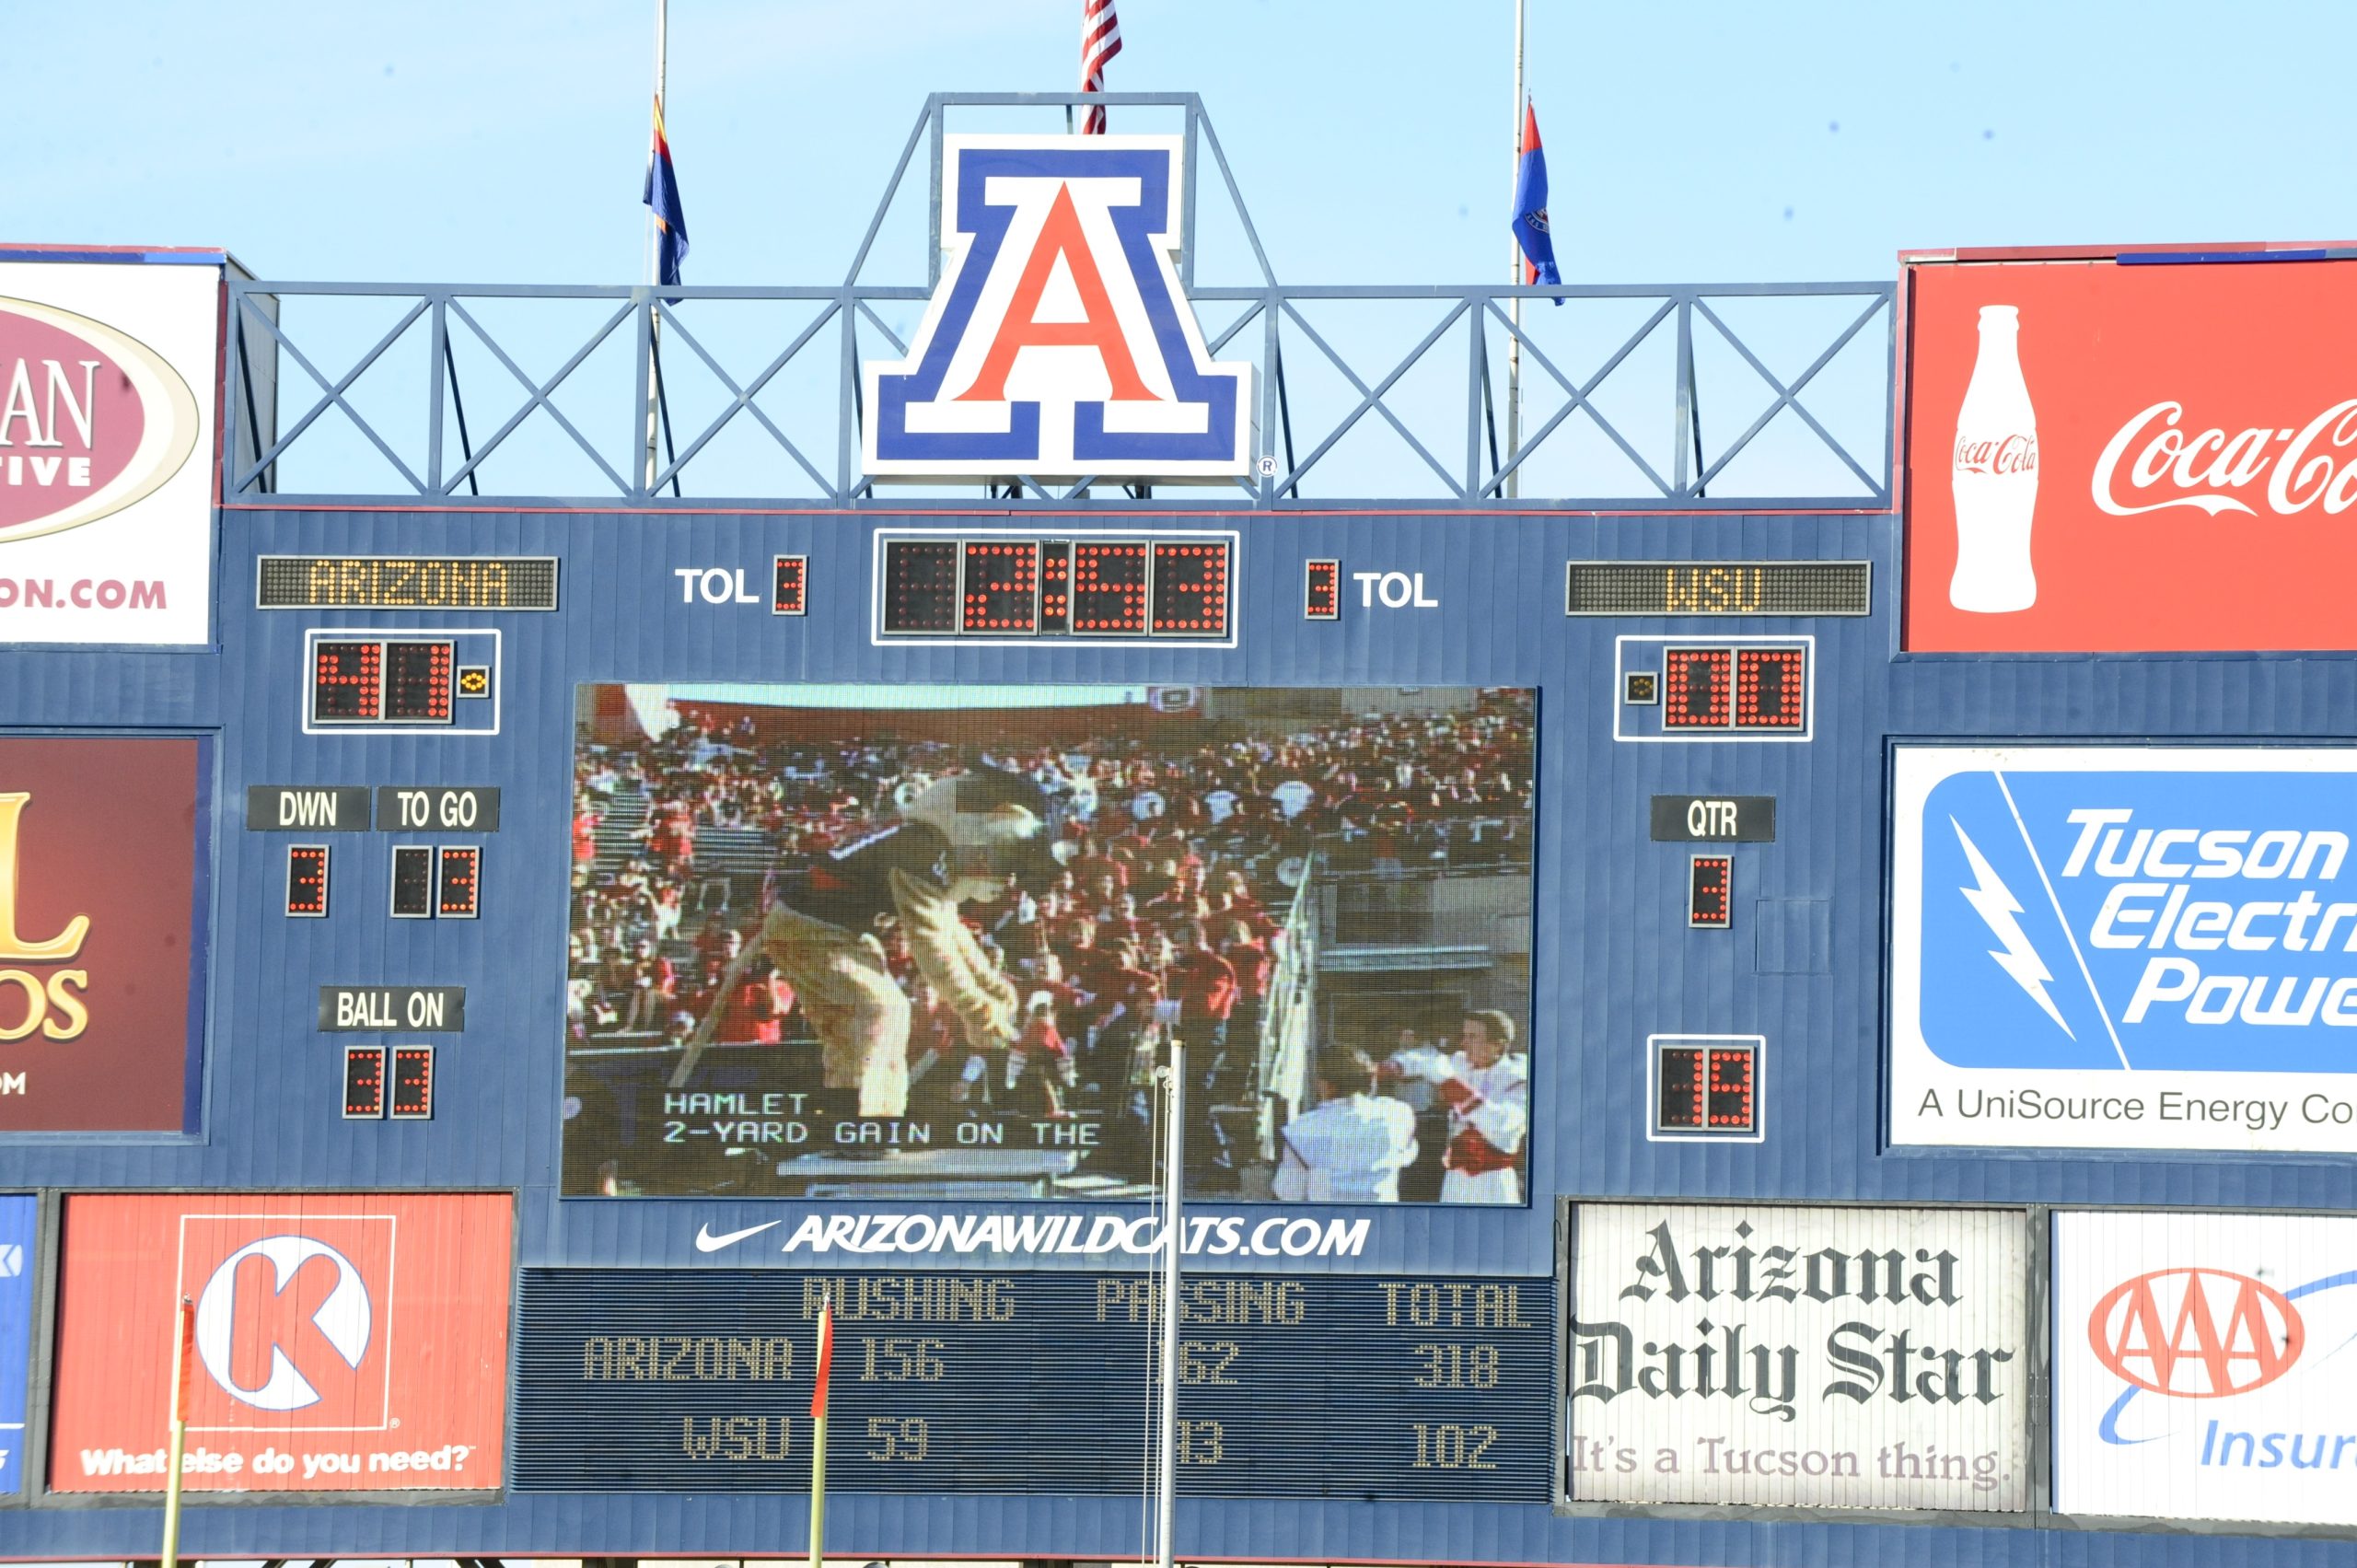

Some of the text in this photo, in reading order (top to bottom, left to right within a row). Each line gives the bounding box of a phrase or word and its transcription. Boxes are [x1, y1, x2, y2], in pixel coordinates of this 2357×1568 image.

[0, 456, 90, 487] IVE
[1956, 434, 2036, 474] Coca-Cola
[0, 578, 167, 610] ON.COM
[309, 559, 507, 606] ARIZONA
[675, 568, 760, 604] TOL
[1353, 571, 1438, 609] TOL
[1666, 568, 1762, 612] WSU
[279, 791, 337, 826] DWN
[397, 791, 477, 827] TO GO
[1688, 799, 1736, 836] QTR
[2061, 808, 2349, 879] Tucson
[289, 851, 325, 911] 3
[1692, 860, 1727, 920] 3
[337, 992, 444, 1028] BALL ON
[1918, 1088, 1944, 1117] A
[1957, 1089, 2144, 1120] UniSource
[2160, 1091, 2288, 1130] Energy
[664, 1122, 1101, 1145] 2-YARD GAIN ON THE
[782, 1214, 1371, 1256] ARIZONAWILDCATS.COM
[1620, 1219, 1964, 1307] Arizona
[802, 1277, 1014, 1320] RUSHING
[1378, 1283, 1531, 1328] TOTAL
[2114, 1269, 2285, 1396] AAA
[584, 1337, 793, 1380] ARIZONA
[861, 1338, 945, 1381] 156
[1414, 1344, 1500, 1388] 318
[1569, 1313, 2016, 1423] Daily Star
[80, 1445, 469, 1479] What else do you need?
[682, 1417, 791, 1460] WSU
[867, 1418, 928, 1461] 59
[1412, 1423, 1499, 1469] 102
[1572, 1434, 2011, 1492] It's a Tucson thing.
